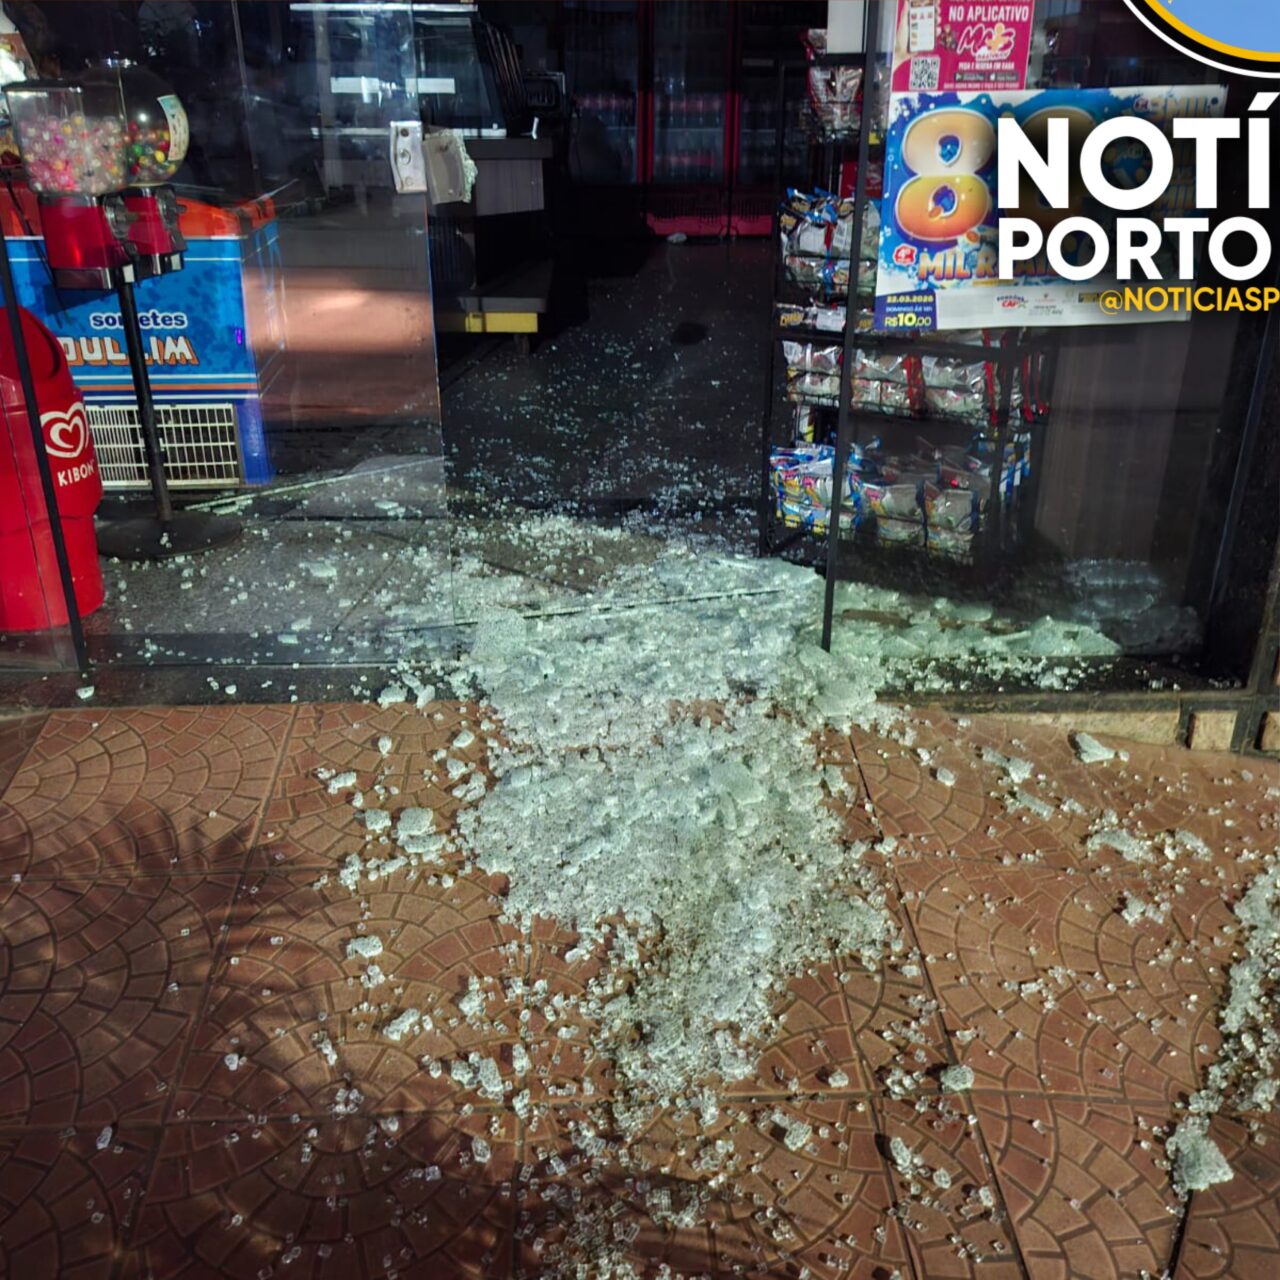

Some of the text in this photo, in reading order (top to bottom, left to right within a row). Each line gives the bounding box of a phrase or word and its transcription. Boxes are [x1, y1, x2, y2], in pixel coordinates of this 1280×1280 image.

[948, 5, 1029, 22] NO APLICATIVO
[917, 250, 972, 280] MIL
[57, 463, 96, 488] KIBON
